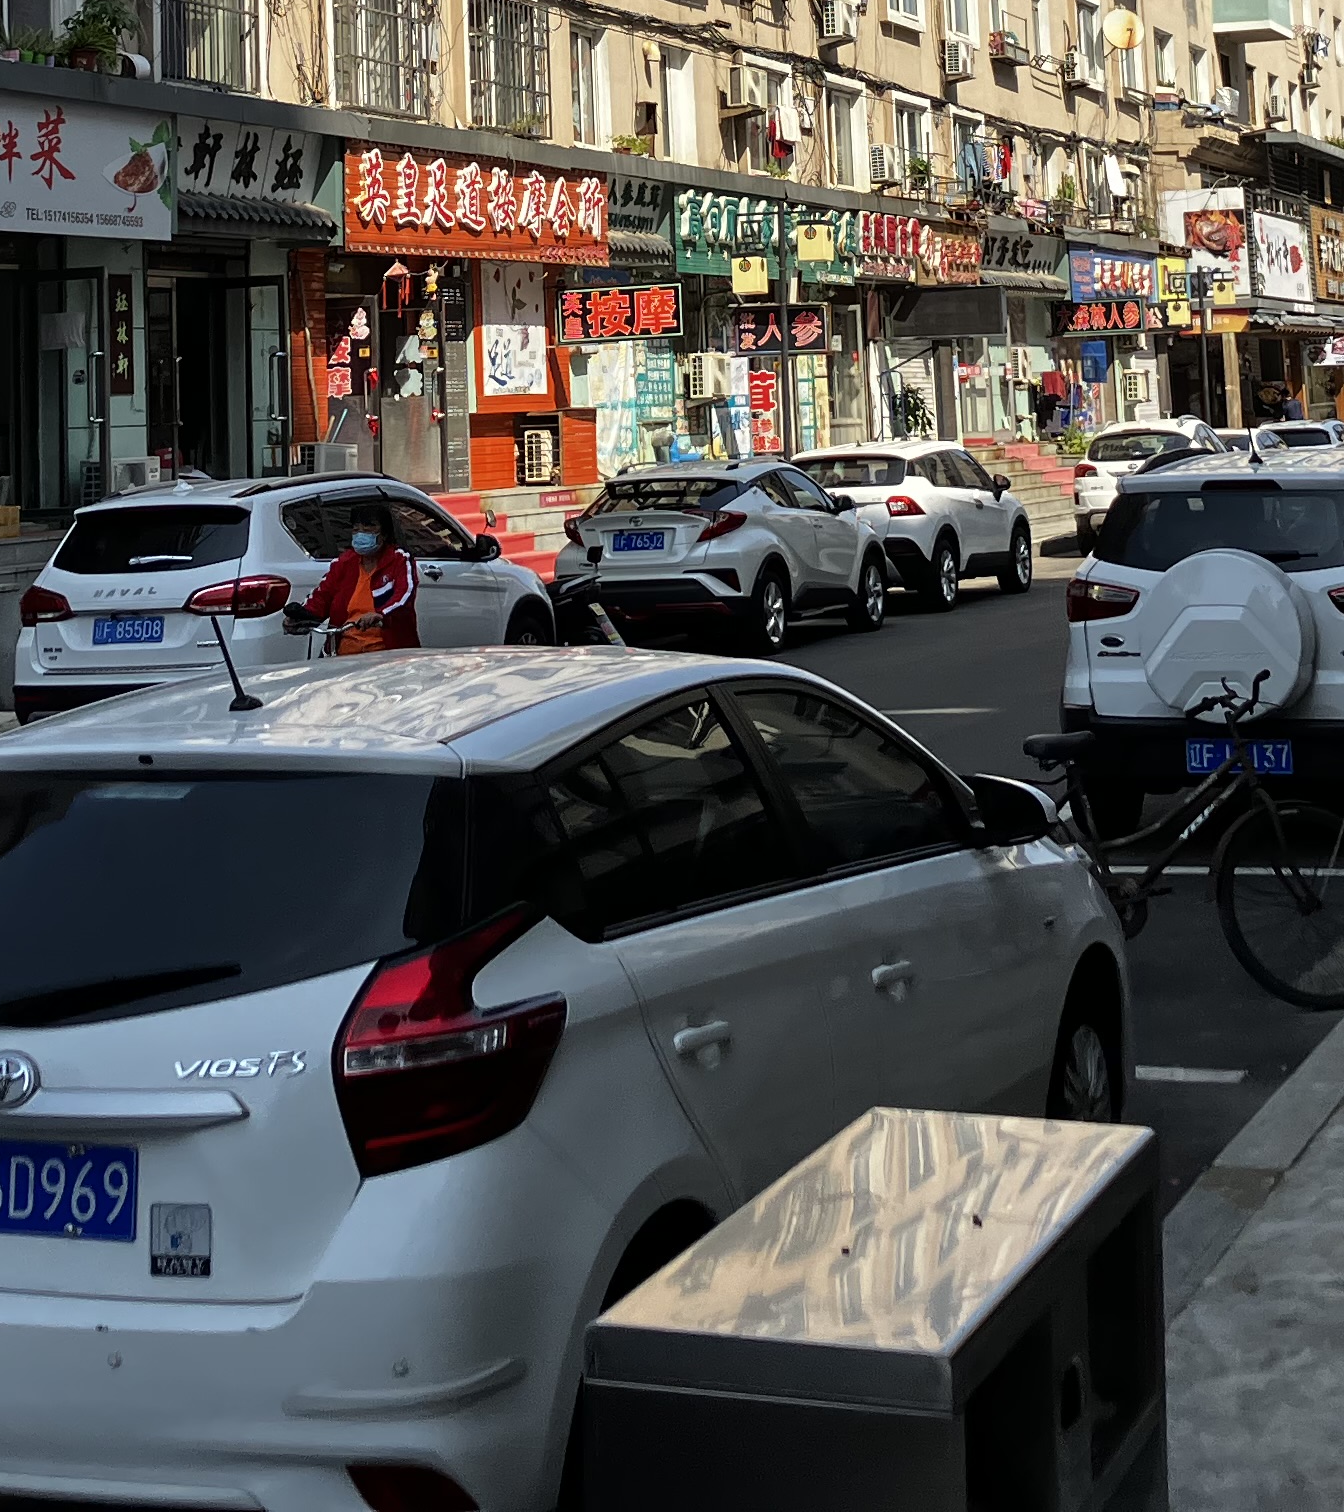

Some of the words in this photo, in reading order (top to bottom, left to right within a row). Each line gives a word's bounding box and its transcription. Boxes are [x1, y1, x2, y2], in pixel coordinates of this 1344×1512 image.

[353, 148, 605, 242] 英皇足道按摩会所
[562, 291, 585, 340] 英皇
[586, 286, 677, 338] 按摩
[757, 310, 823, 348] 人参
[1057, 301, 1140, 333] 大森林人参
[92, 586, 159, 599] HAVAL
[1188, 743, 1289, 769] 辽F·1137
[173, 1055, 261, 1081] VIOS
